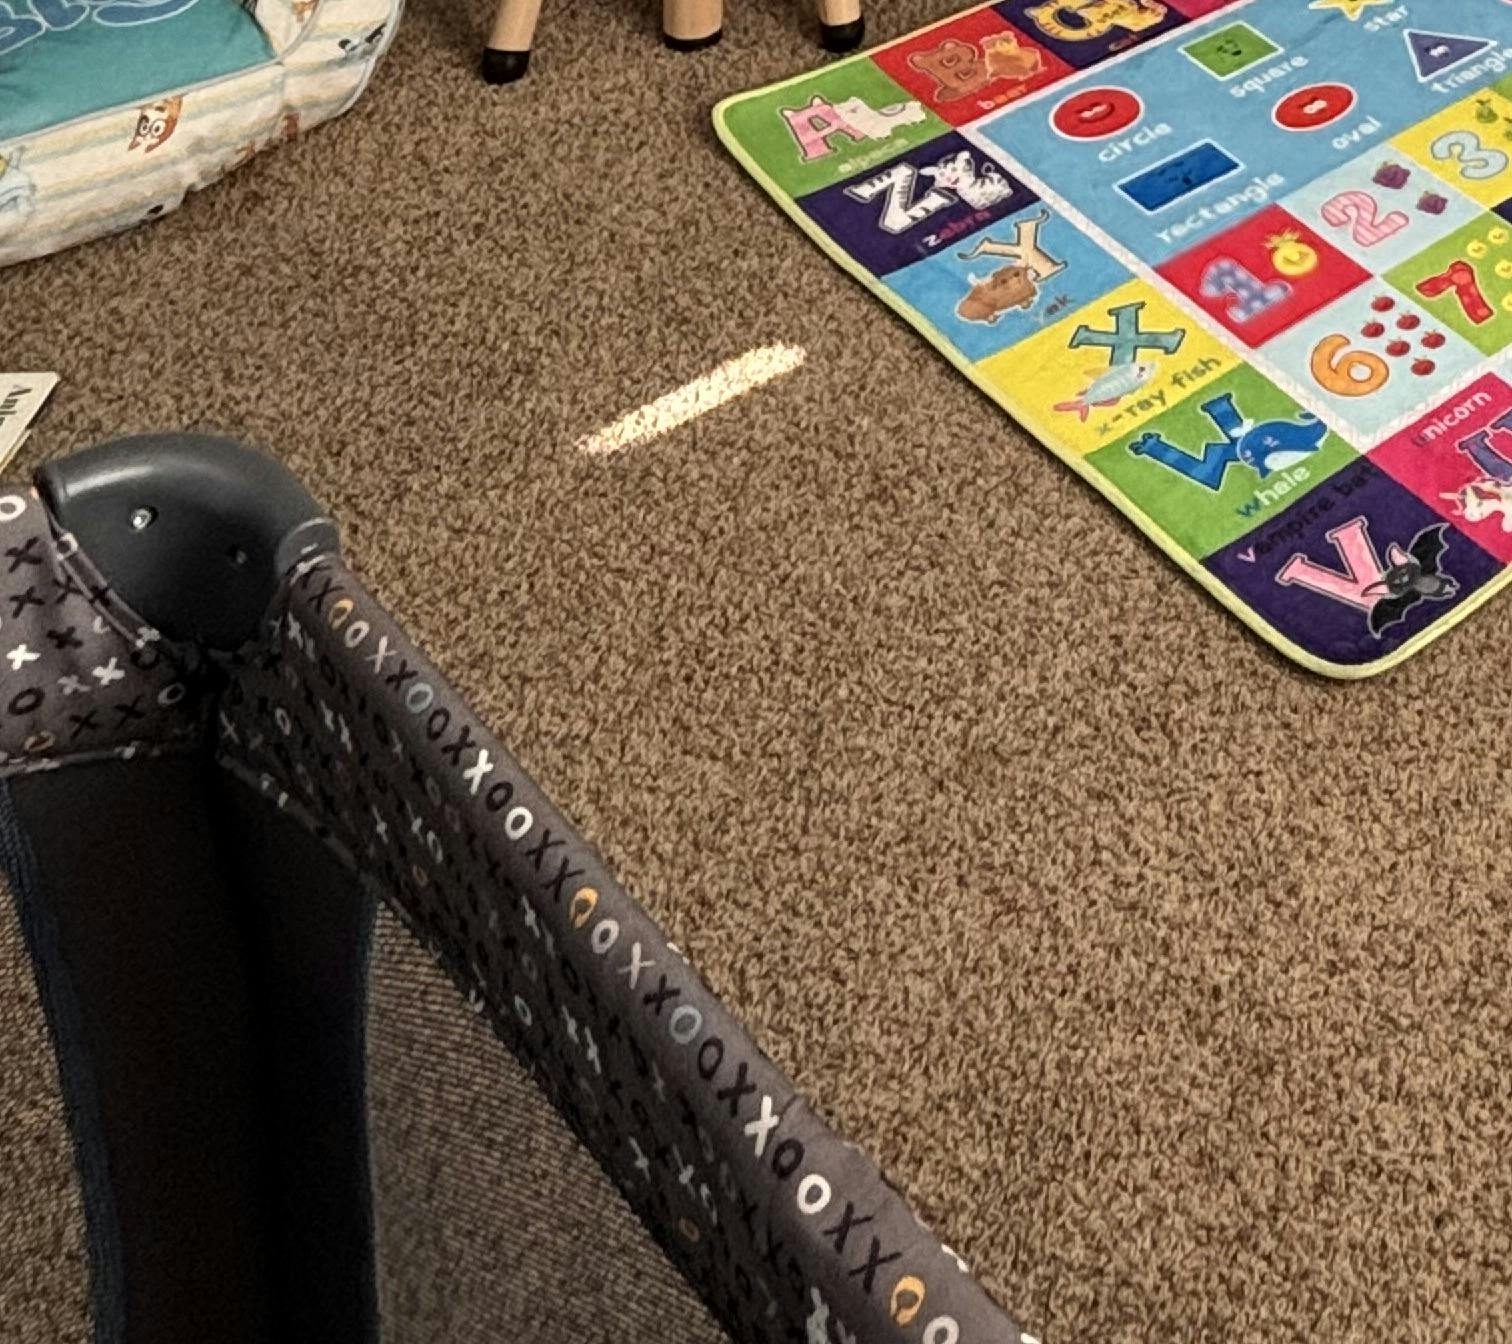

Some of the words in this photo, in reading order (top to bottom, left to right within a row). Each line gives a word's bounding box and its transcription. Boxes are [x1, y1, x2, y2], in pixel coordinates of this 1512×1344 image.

[1362, 5, 1409, 33] star
[1229, 55, 1309, 98] square
[1098, 121, 1173, 162] circle
[1330, 115, 1383, 150] oval
[1430, 130, 1509, 180] 3
[1155, 172, 1286, 243] rectangle
[1320, 190, 1411, 248] 2
[1200, 259, 1294, 324] 1
[1415, 259, 1494, 326] 7
[1310, 332, 1391, 398] 6
[1098, 389, 1168, 436] x-ray
[1171, 355, 1223, 391] fish
[1411, 390, 1493, 447] unicorn
[1235, 465, 1312, 518] whale
